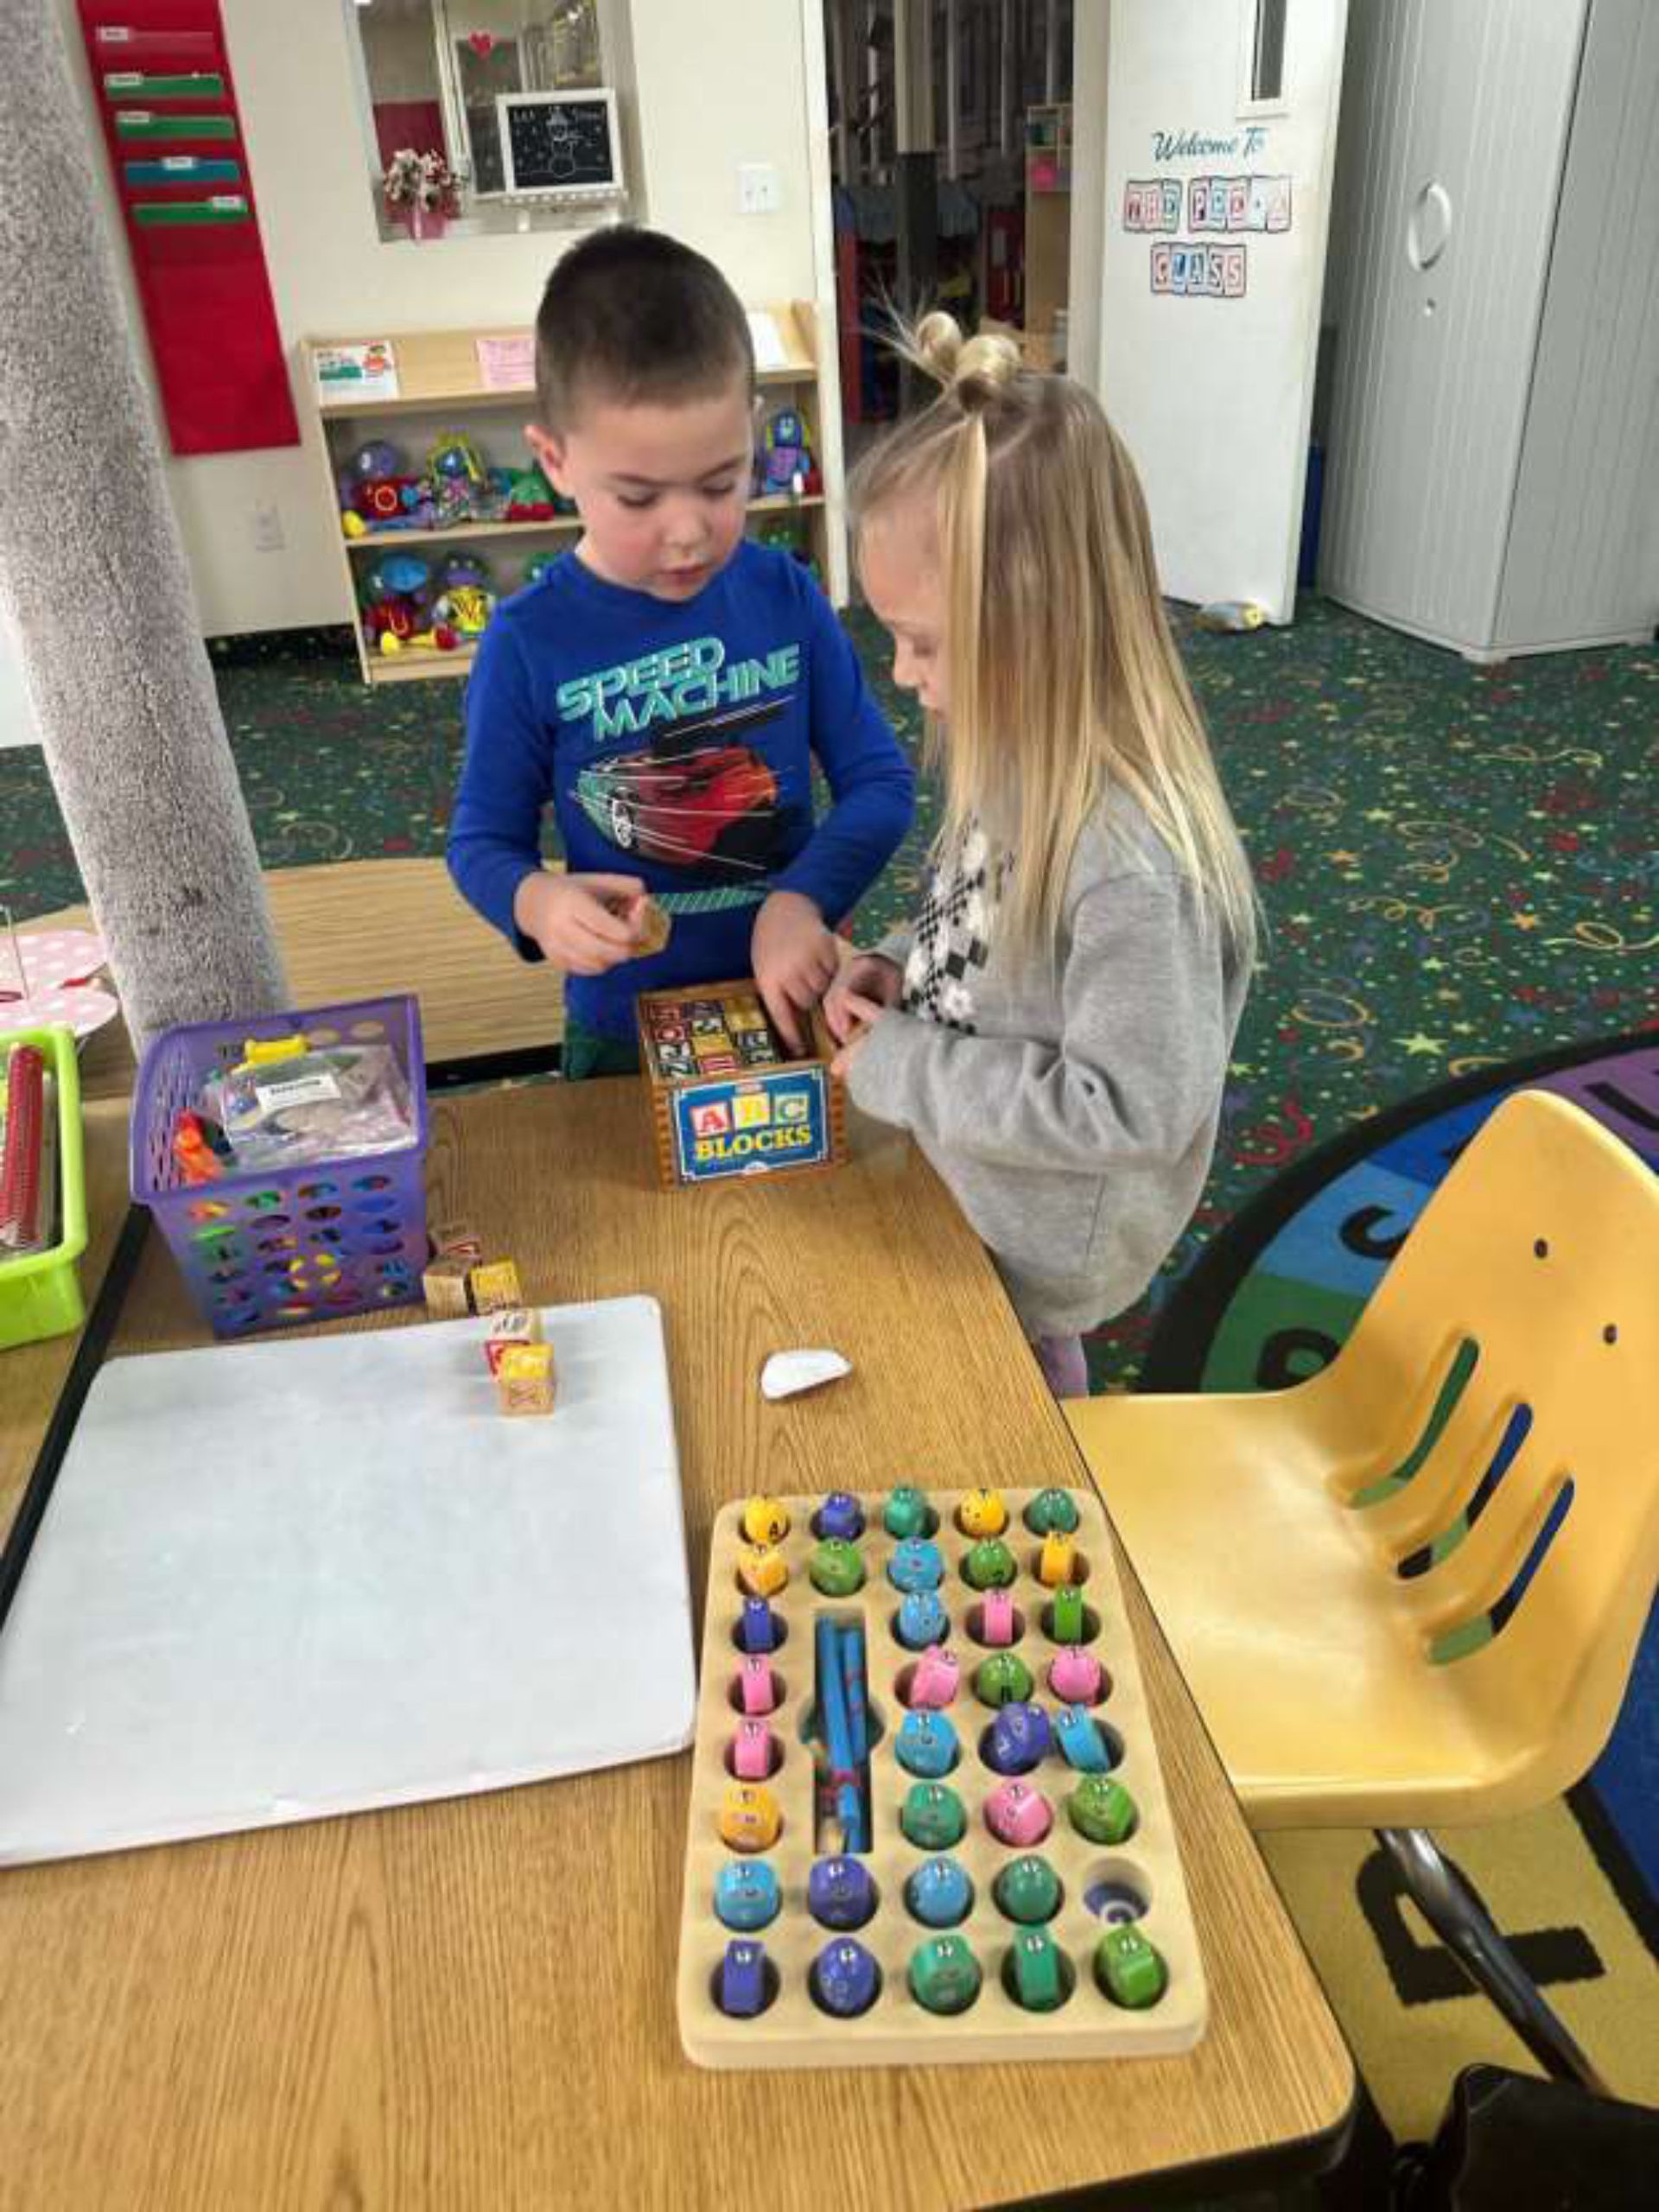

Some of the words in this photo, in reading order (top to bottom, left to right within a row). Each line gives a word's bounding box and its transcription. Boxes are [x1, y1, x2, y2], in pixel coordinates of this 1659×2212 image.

[1152, 130, 1236, 162] Welcome
[1243, 126, 1268, 159] To
[1153, 248, 1244, 292] CLASS
[556, 637, 725, 722] SPEED
[593, 644, 799, 741] MACHINE
[696, 1124, 813, 1160] BLOCKS
